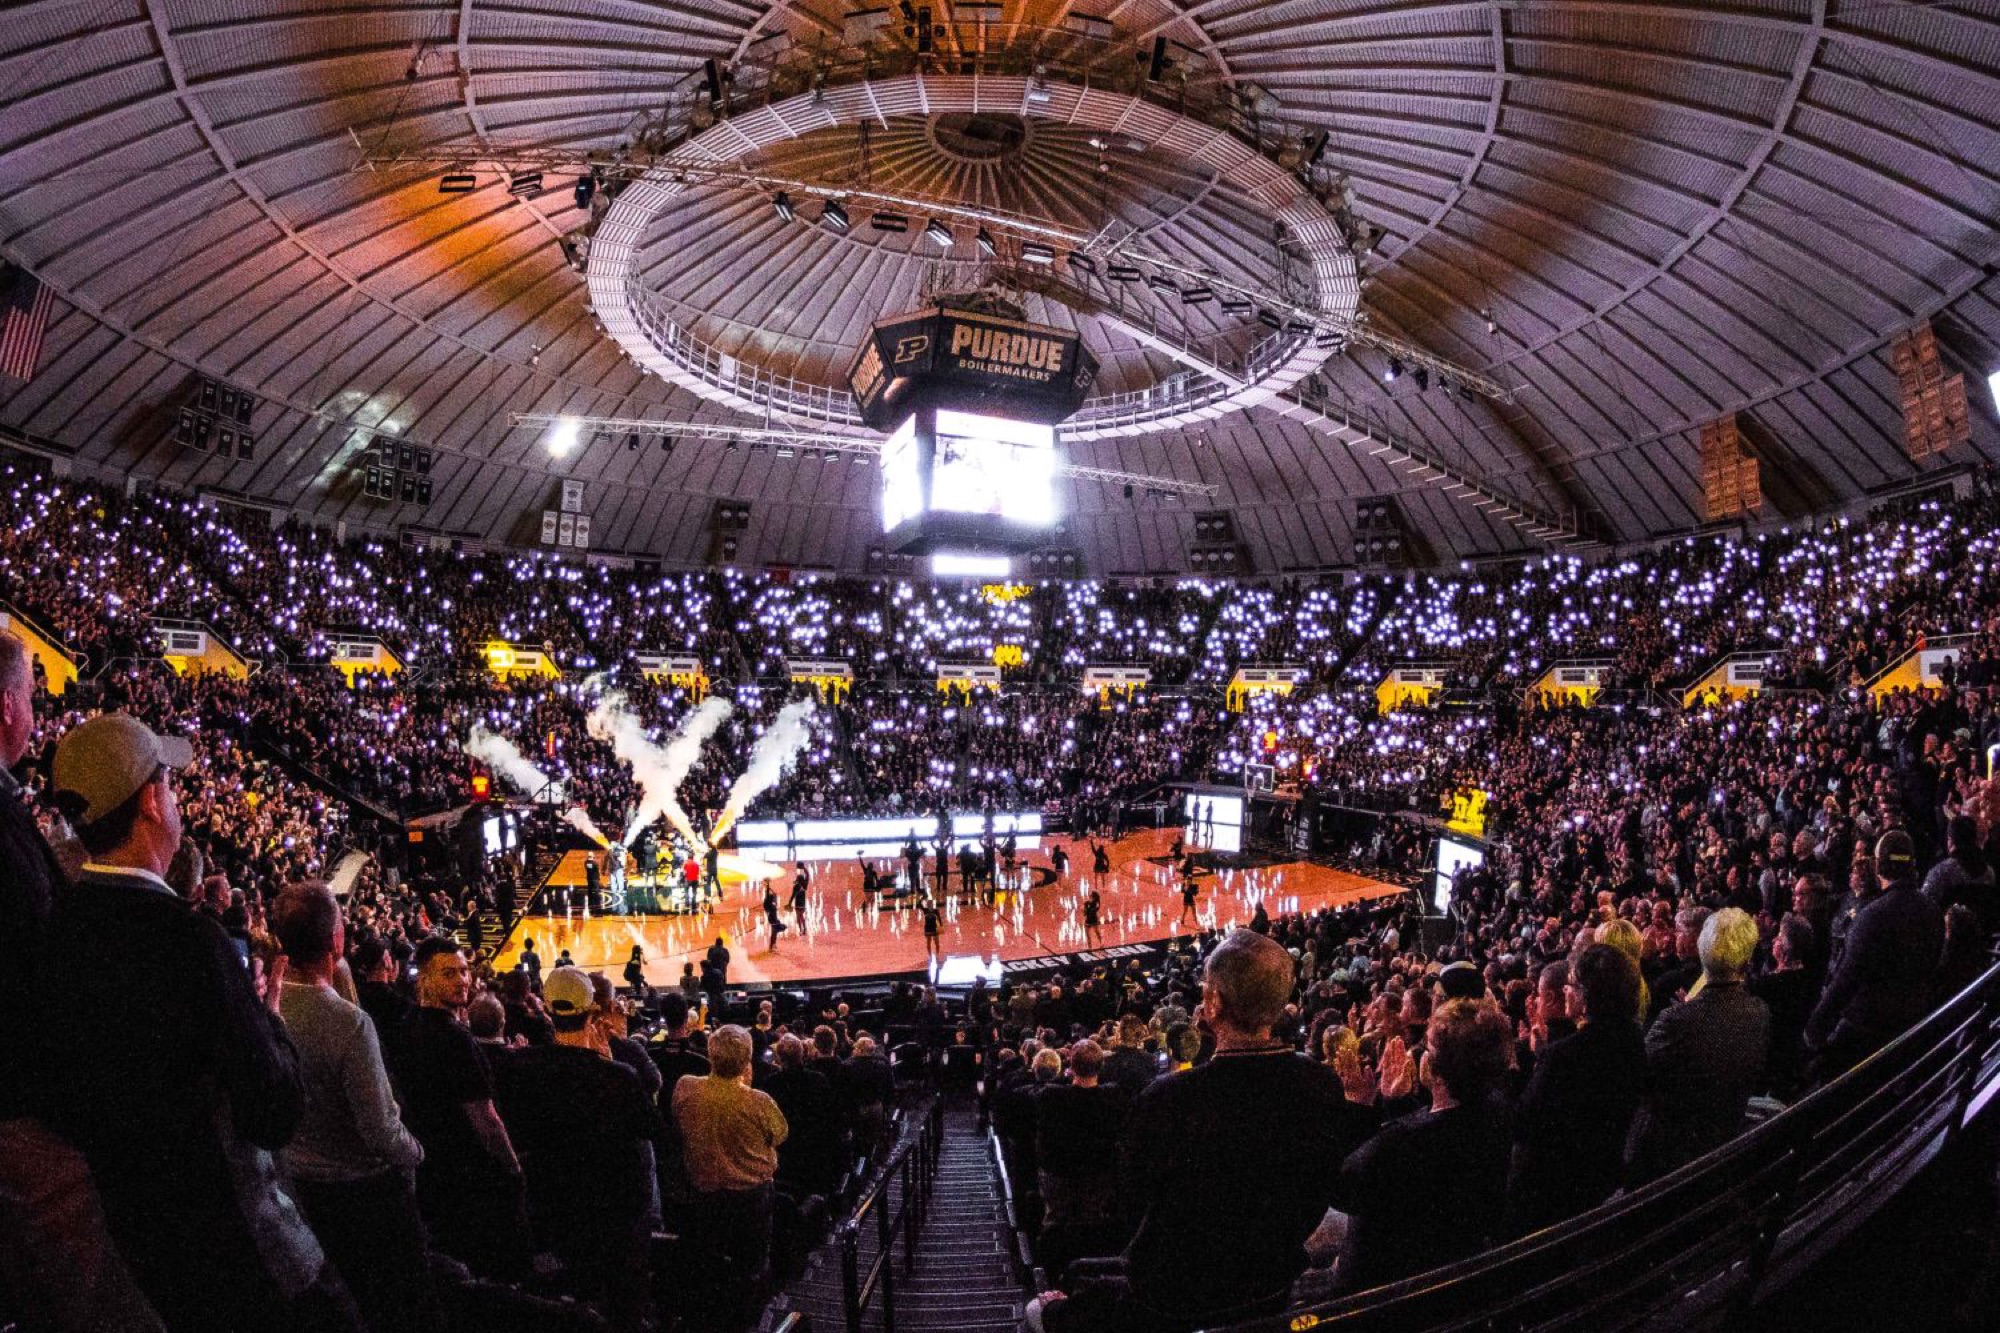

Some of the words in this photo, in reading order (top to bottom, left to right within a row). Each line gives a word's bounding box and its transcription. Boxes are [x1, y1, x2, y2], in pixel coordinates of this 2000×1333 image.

[895, 335, 929, 363] P
[951, 324, 1064, 372] PURDUE
[959, 359, 1051, 382] BOILERMAKERS
[1000, 955, 1070, 974] ACKEY
